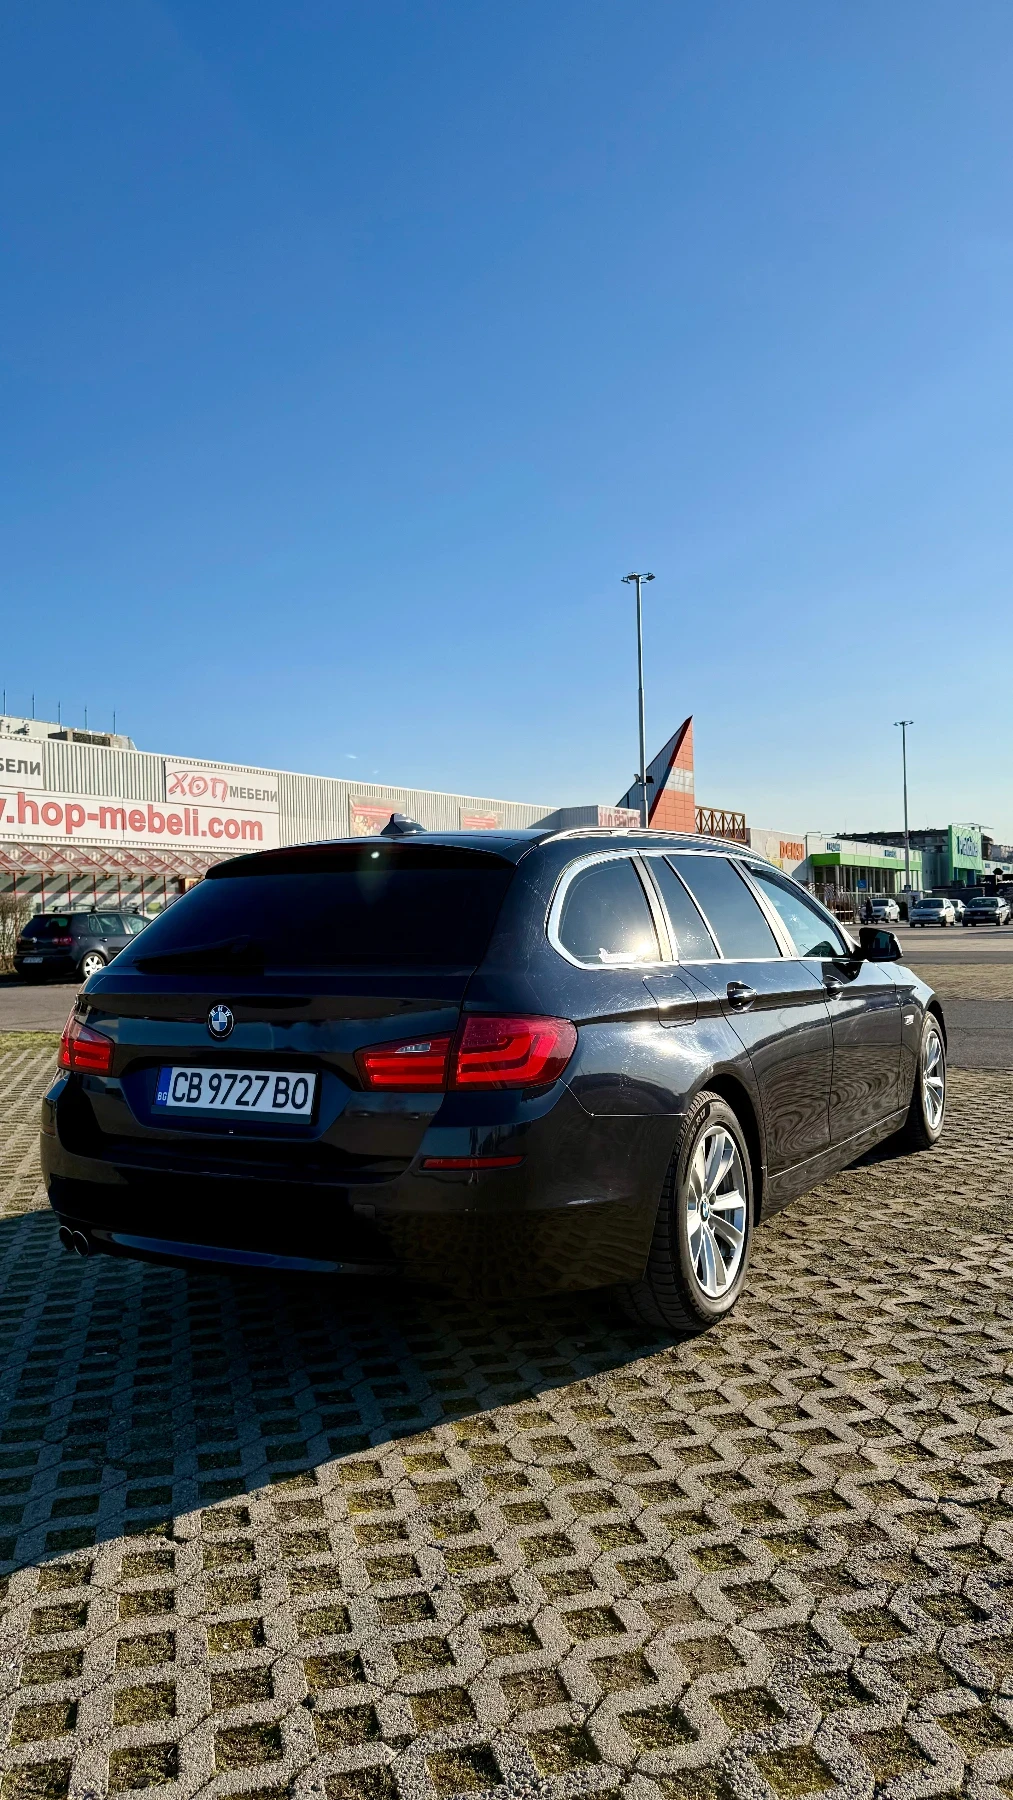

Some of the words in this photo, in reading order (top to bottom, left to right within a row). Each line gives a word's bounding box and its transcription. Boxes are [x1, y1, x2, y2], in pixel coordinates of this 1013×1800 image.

[229, 785, 278, 803] МЕБЕЛИ
[0, 791, 263, 841] .hop-mebeli.com
[157, 1091, 168, 1102] BG
[171, 1071, 203, 1104] CB
[208, 1072, 270, 1107] 9727
[271, 1075, 309, 1110] BO
